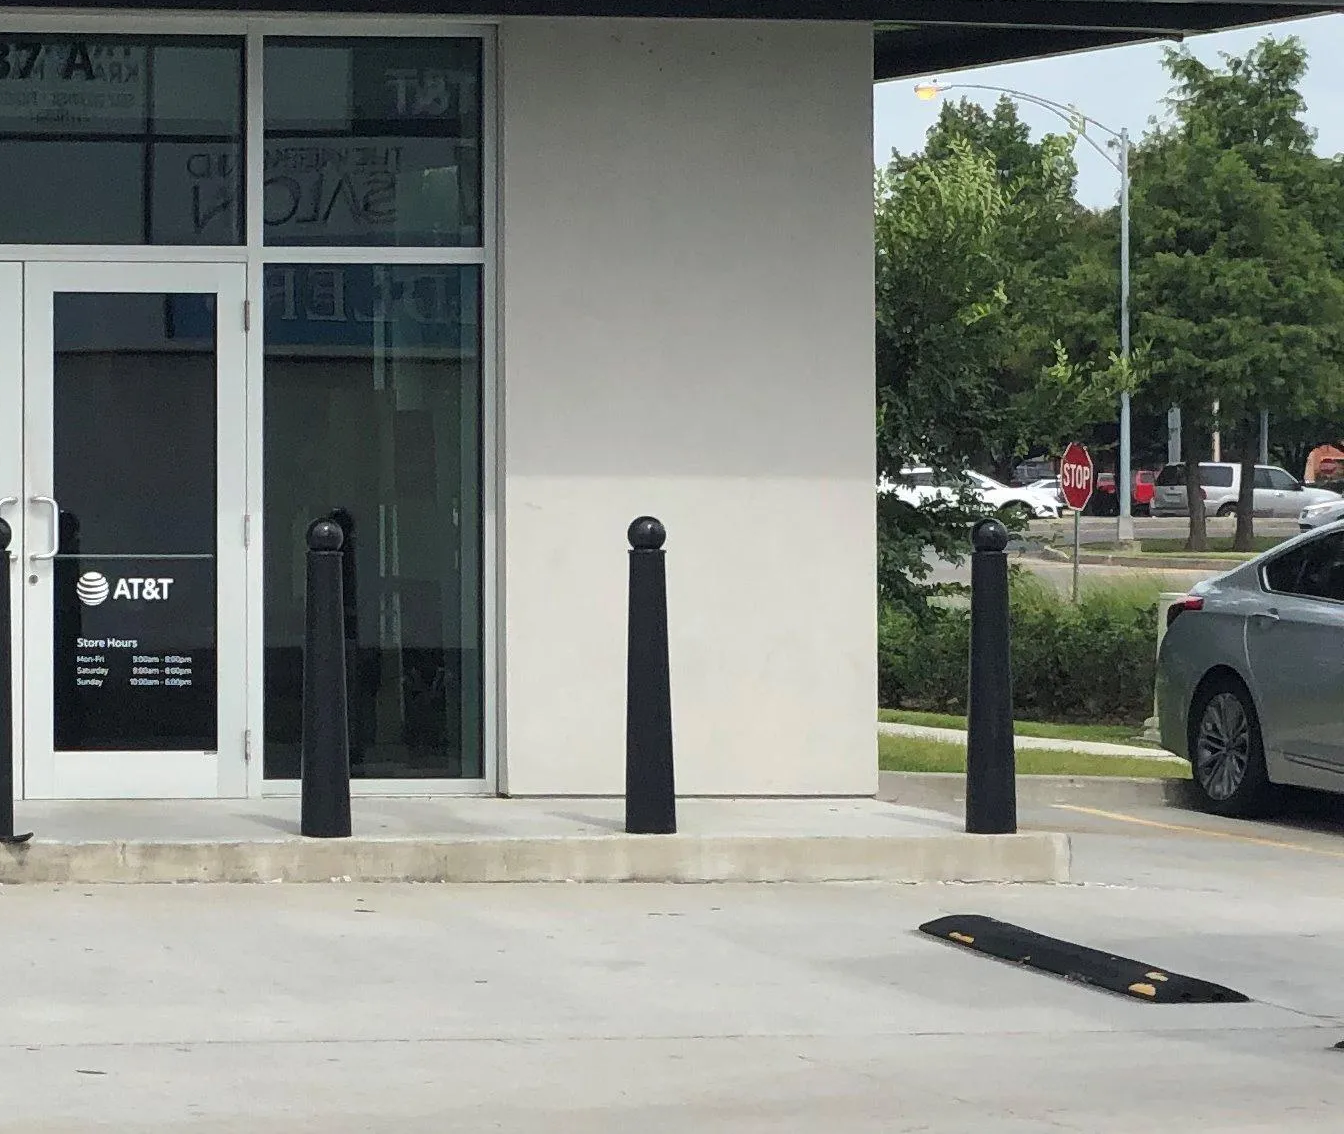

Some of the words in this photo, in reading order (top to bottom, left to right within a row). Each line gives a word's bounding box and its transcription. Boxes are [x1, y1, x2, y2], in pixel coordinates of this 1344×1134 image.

[63, 41, 96, 80] A
[1063, 462, 1090, 489] STOP
[113, 578, 174, 600] AT&T
[77, 638, 106, 648] Store
[107, 638, 138, 648] Hours
[77, 667, 109, 676] Saturday
[77, 678, 103, 687] Sunday
